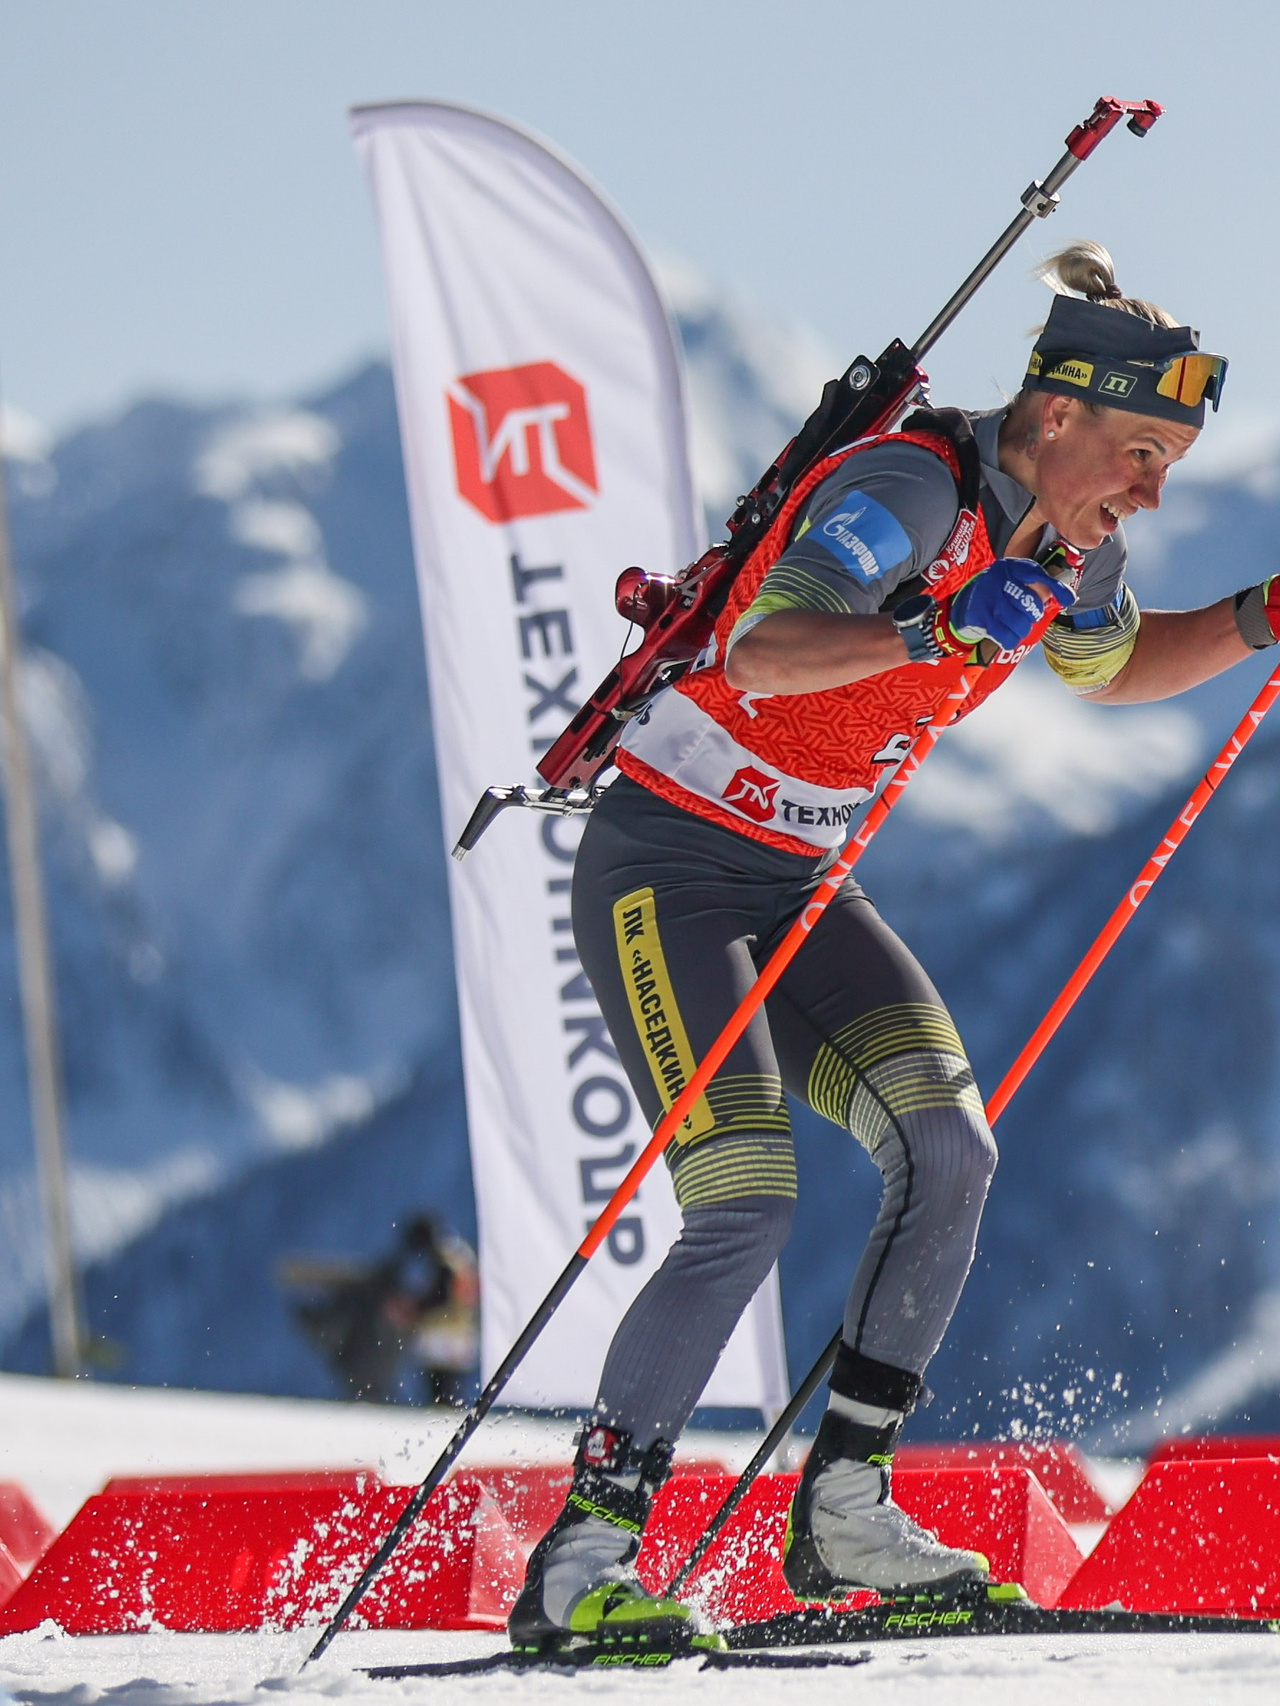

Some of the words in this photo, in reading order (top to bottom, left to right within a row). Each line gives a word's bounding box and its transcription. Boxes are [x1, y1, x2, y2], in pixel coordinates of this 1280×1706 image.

[623, 906, 645, 946] ЛК
[631, 949, 693, 1131] «НАСЕДКИН»
[566, 1493, 642, 1535] FISCHER
[884, 1610, 973, 1628] FISCHER
[592, 1653, 673, 1667] FISCHER
